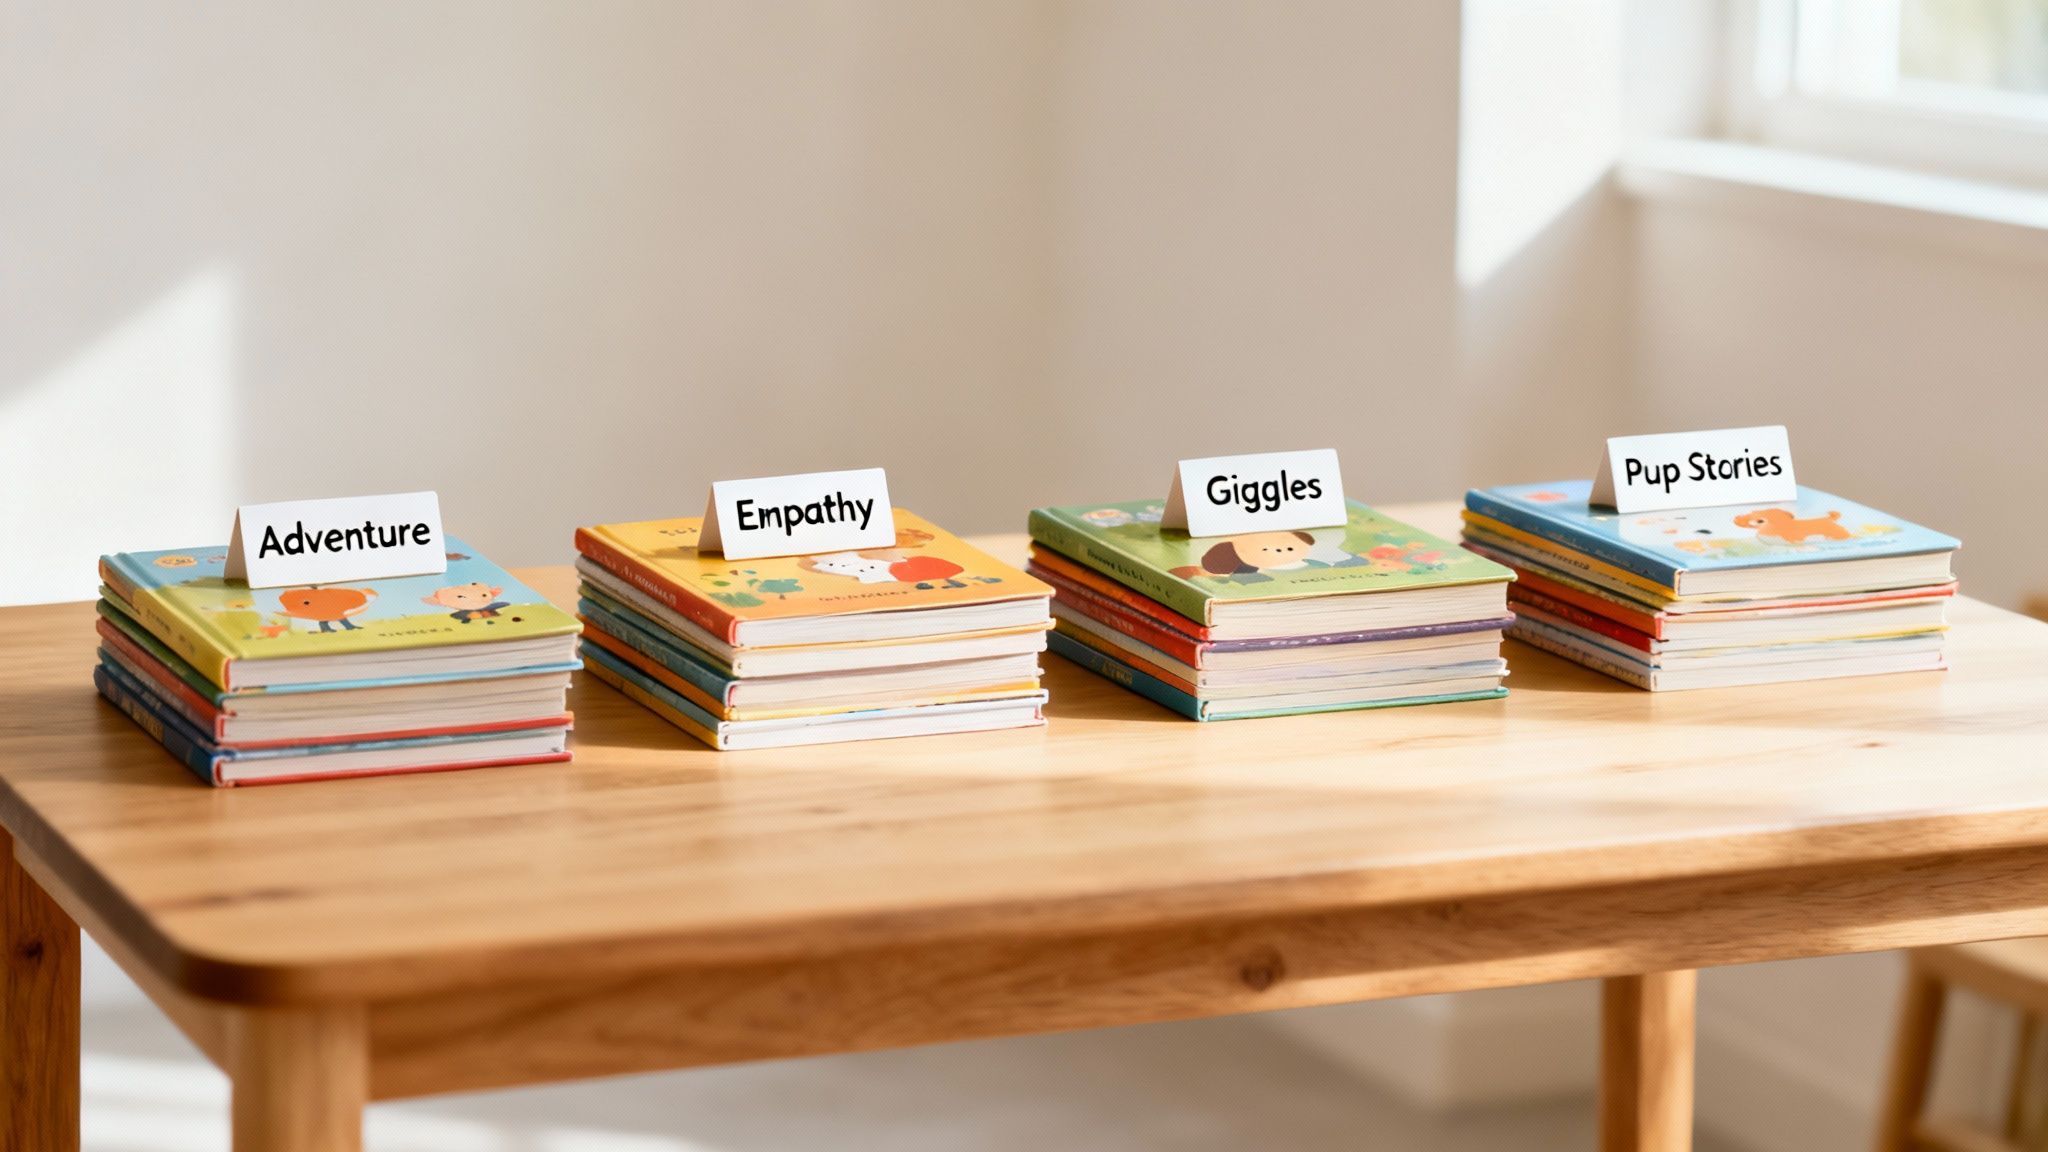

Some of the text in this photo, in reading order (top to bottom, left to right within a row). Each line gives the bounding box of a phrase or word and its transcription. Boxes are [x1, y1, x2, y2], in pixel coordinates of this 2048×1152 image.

[1206, 470, 1323, 514] Giggles
[1625, 448, 1783, 494] Pup Stories
[735, 491, 875, 537] Empathy
[258, 520, 432, 560] Adventure
